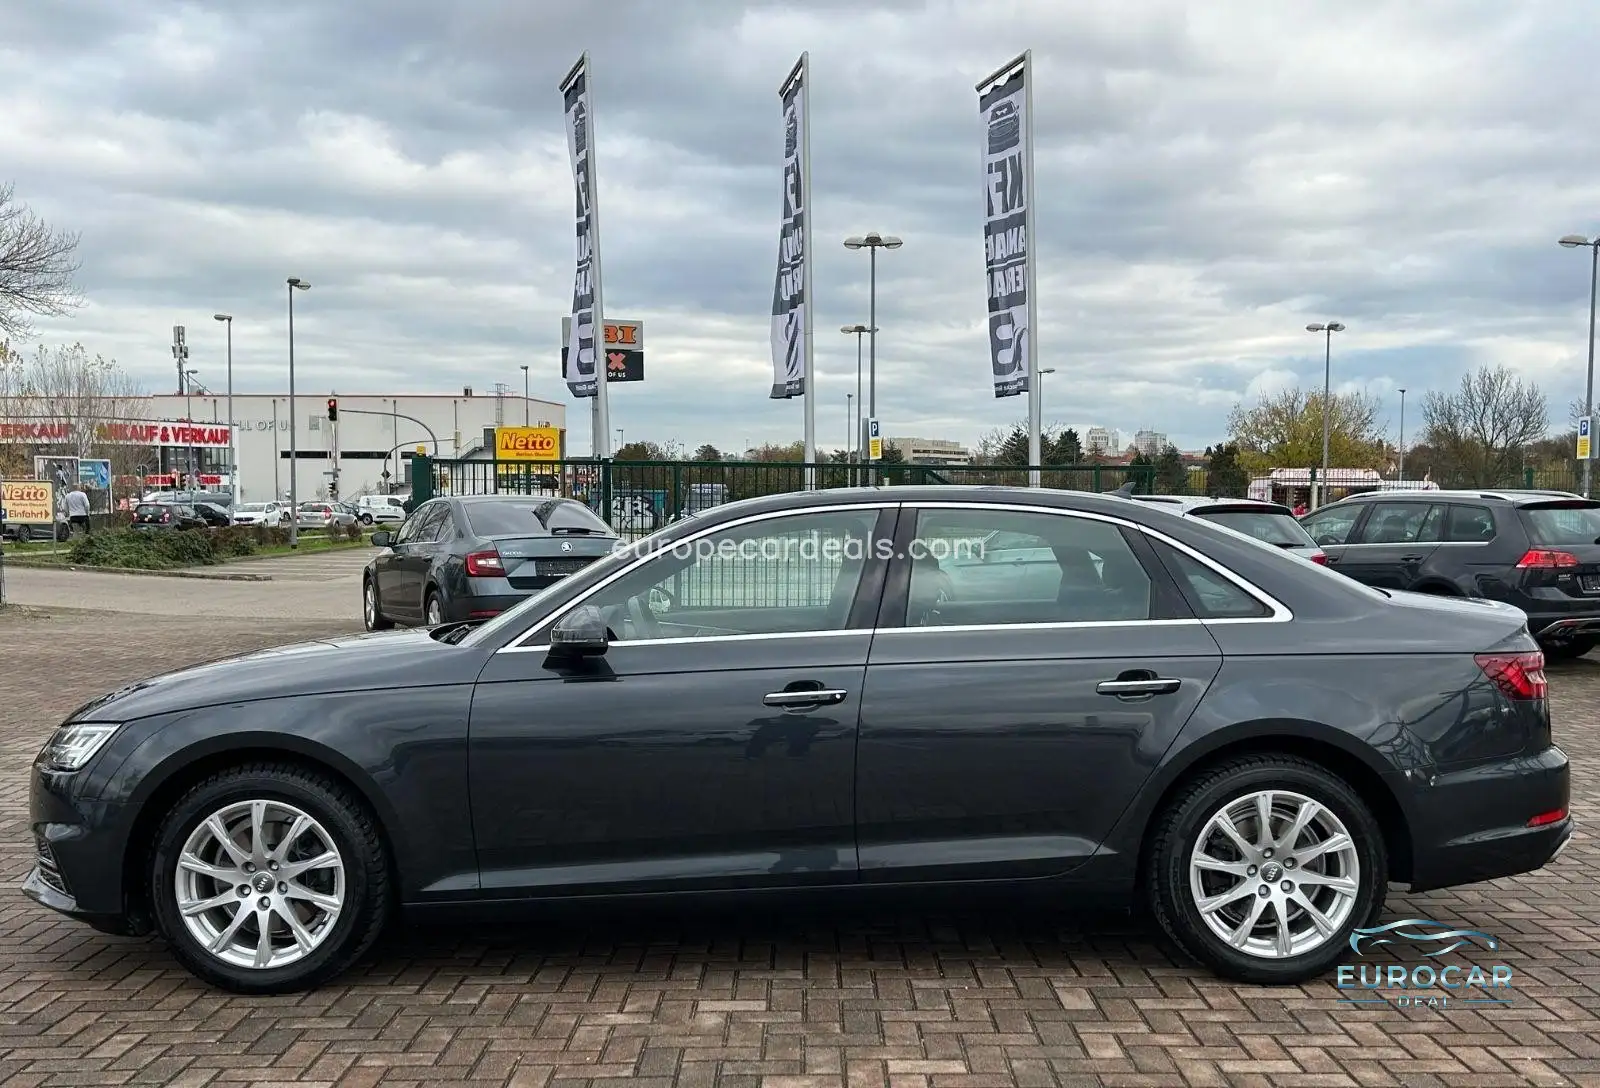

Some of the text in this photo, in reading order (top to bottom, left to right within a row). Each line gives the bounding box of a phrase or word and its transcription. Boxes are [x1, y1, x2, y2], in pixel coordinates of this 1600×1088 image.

[160, 426, 170, 443] &
[171, 426, 229, 444] VERKAUF
[501, 432, 554, 450] Netto
[1, 484, 48, 500] Netto
[9, 510, 43, 518] Einfahrt
